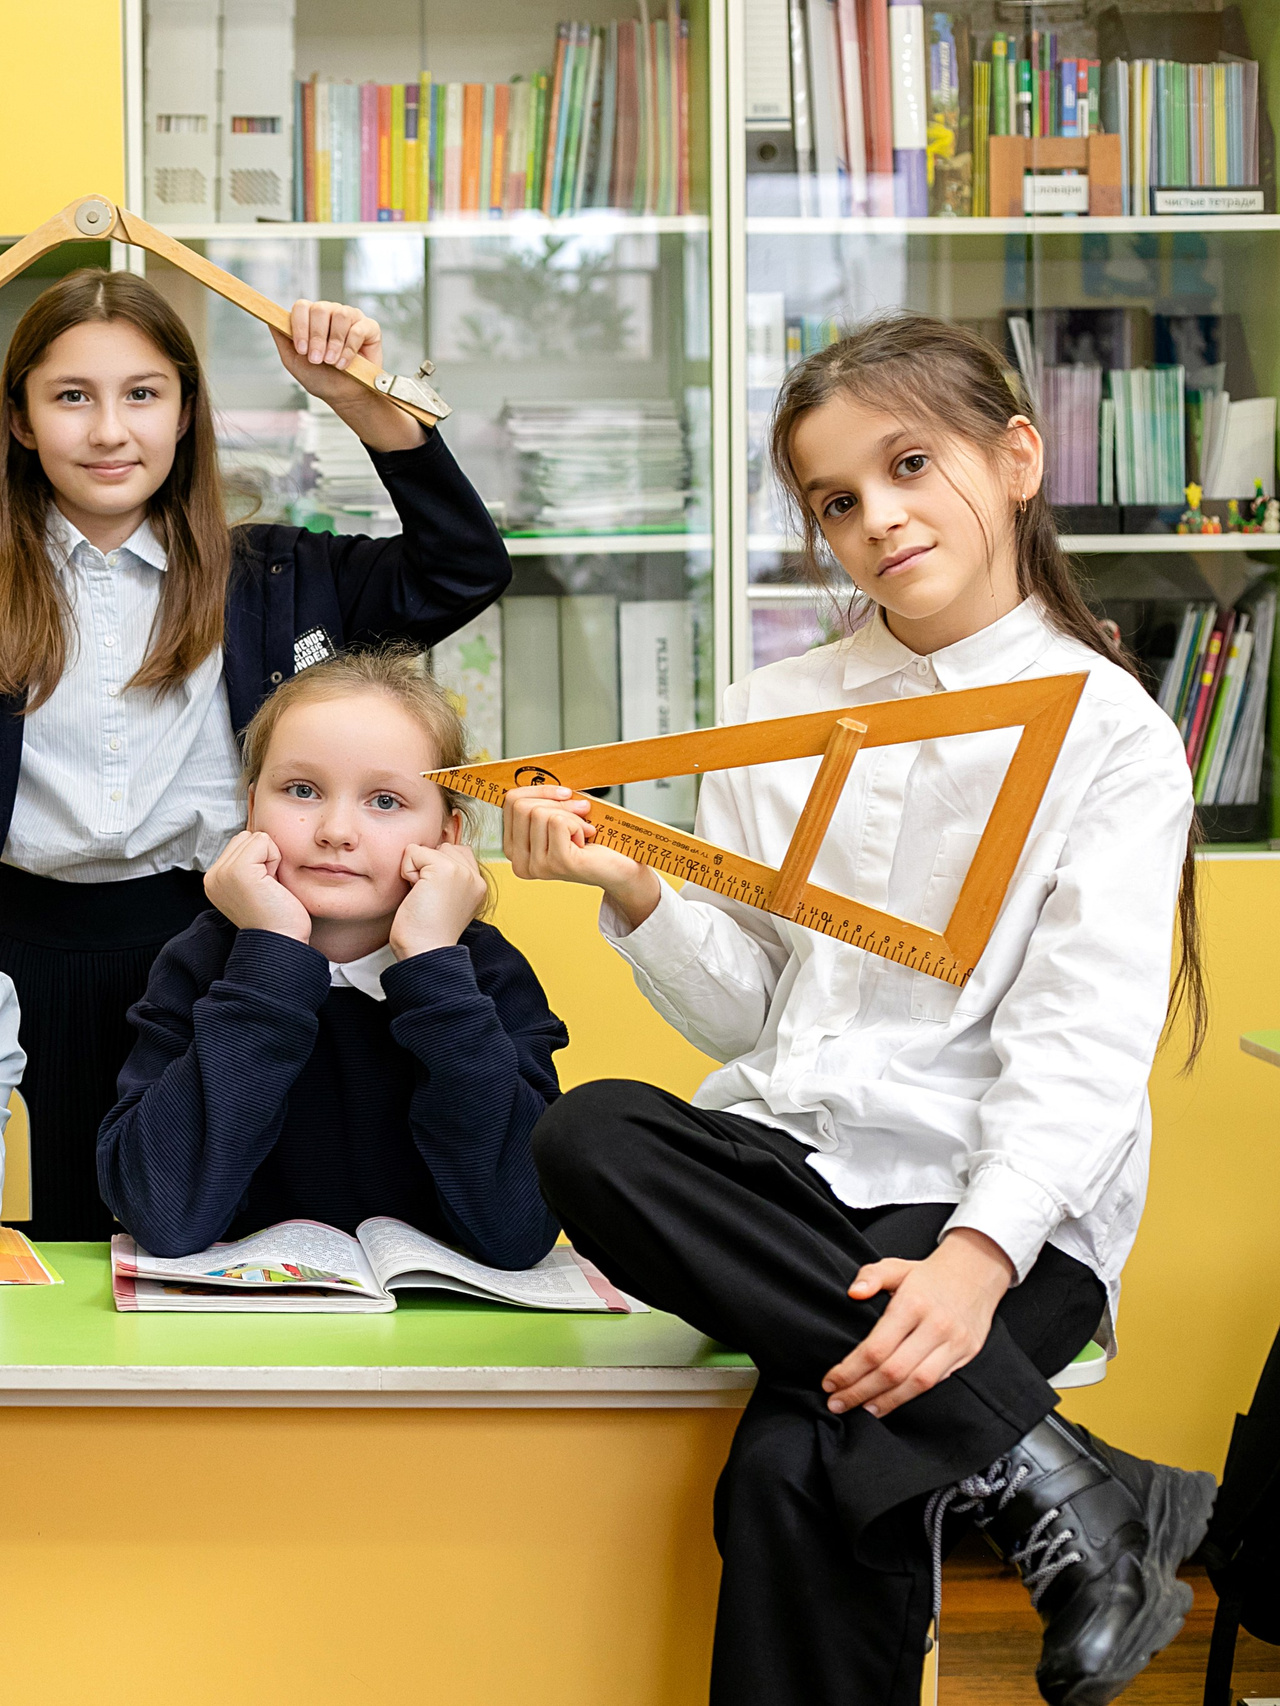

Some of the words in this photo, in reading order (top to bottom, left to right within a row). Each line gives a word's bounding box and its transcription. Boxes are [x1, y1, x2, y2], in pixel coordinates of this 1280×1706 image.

[1164, 197, 1204, 207] чистые
[1208, 197, 1256, 208] тетради
[294, 630, 325, 654] RENDS
[294, 642, 323, 662] CLASSIC
[656, 637, 669, 700] листы
[462, 773, 473, 782] 37
[475, 777, 486, 787] 36
[488, 782, 499, 792] 35
[607, 828, 618, 838] 26
[620, 833, 632, 843] 25
[634, 839, 645, 848] 24
[647, 843, 659, 853] 23
[661, 848, 672, 858] 22
[674, 854, 685, 864] 21
[686, 859, 700, 870] 20
[700, 864, 710, 874] 19
[714, 870, 724, 878] 18
[727, 875, 737, 884] 17
[740, 880, 751, 889] 16
[754, 885, 764, 894] 15
[810, 907, 818, 916] 11
[821, 912, 832, 922] 10
[842, 920, 850, 928] 9
[856, 924, 862, 932] 8
[884, 936, 890, 944] 6
[898, 940, 905, 949] 5
[924, 951, 932, 960] 3
[938, 956, 946, 964] 2
